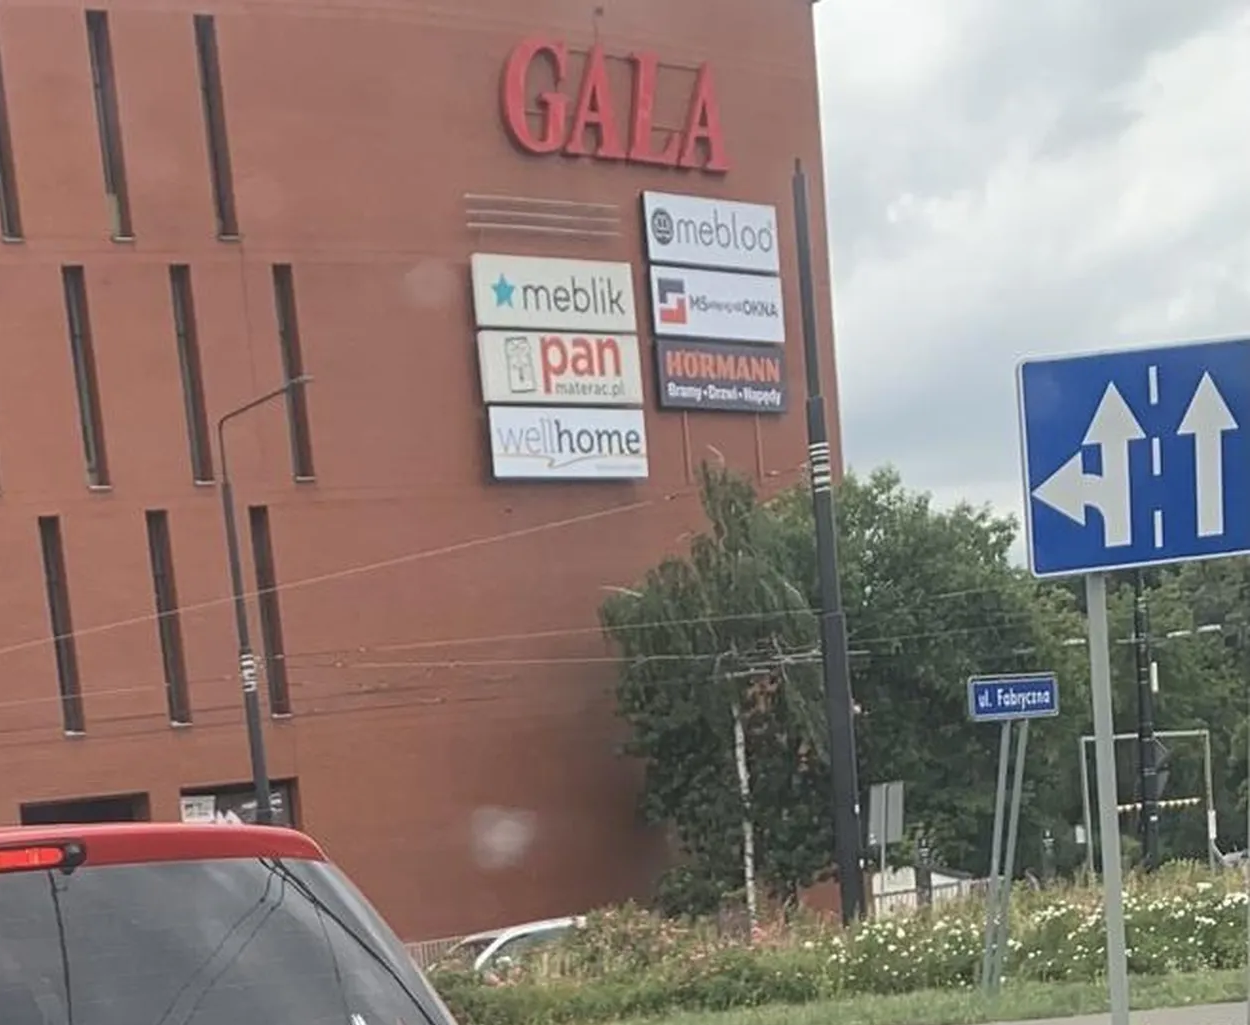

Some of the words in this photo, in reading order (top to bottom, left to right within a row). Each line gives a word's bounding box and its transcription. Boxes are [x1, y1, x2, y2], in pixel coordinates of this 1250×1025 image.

[502, 36, 731, 172] GALA
[522, 276, 625, 316] meblik
[539, 335, 622, 395] pan
[555, 380, 625, 397] materac.pl
[497, 416, 641, 455] wellhome
[978, 689, 992, 708] ul.
[997, 687, 1051, 709] Fabryczna
